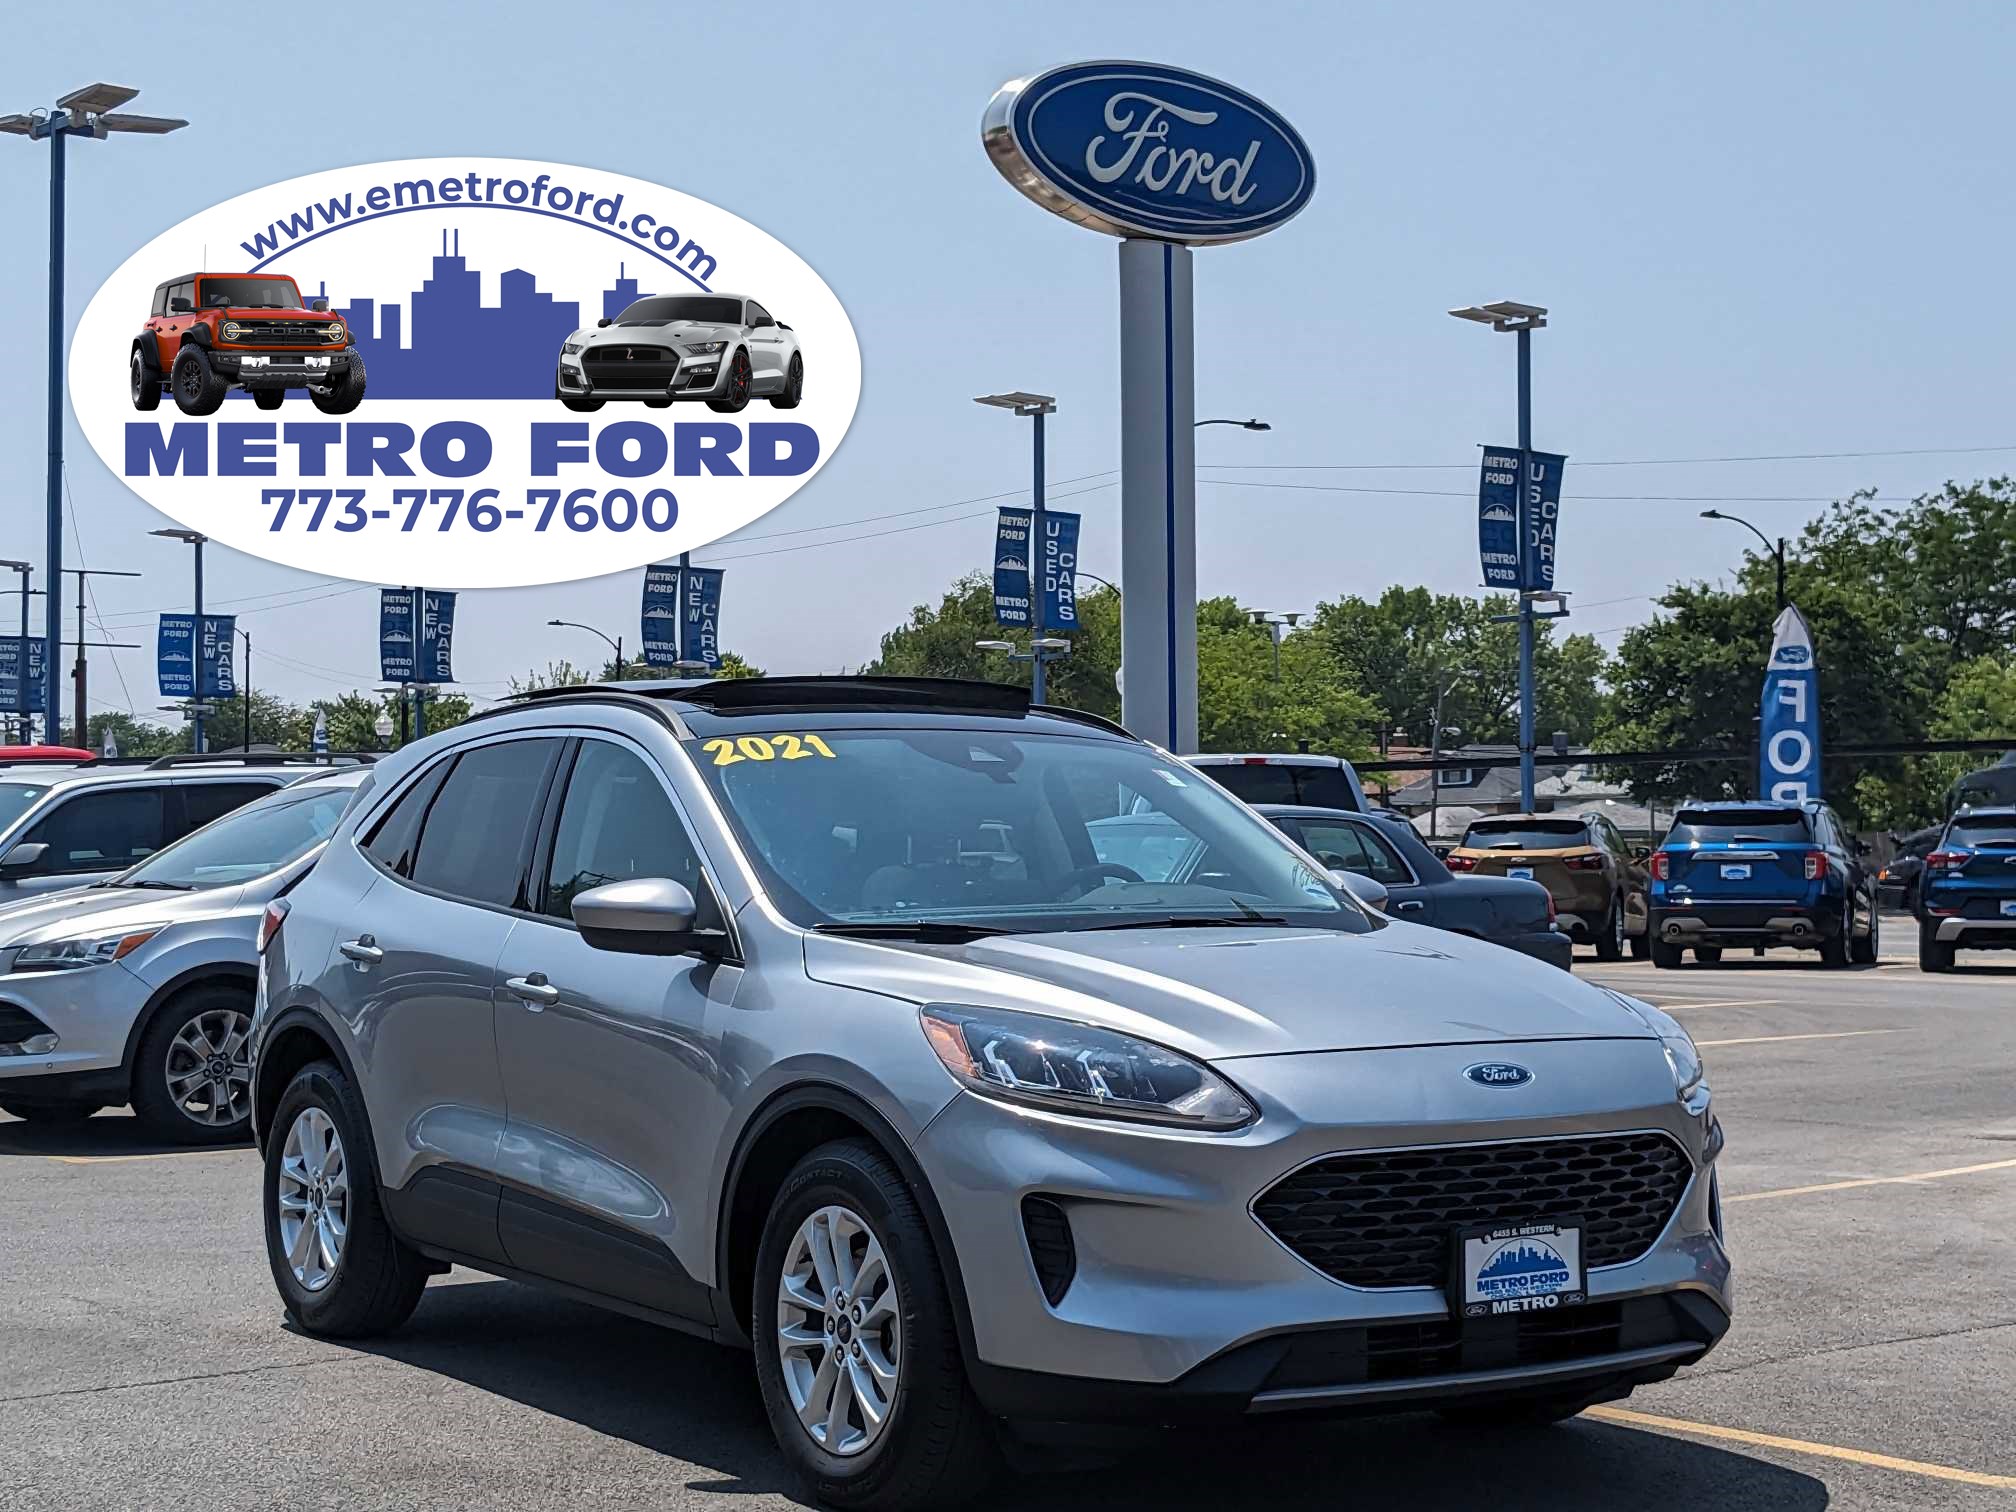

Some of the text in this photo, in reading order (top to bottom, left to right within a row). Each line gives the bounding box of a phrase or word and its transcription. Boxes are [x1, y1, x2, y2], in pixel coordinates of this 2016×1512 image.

[1085, 92, 1262, 206] Ford
[1483, 456, 1518, 470] METRO
[1485, 472, 1514, 485] FORD
[1000, 515, 1030, 527] METRO
[1000, 530, 1025, 540] FORD
[1482, 553, 1516, 565] METRO
[1487, 568, 1516, 580] FORD
[996, 596, 1029, 607] METRO
[1000, 610, 1026, 621] FORD
[702, 734, 837, 766] 2021
[1481, 1066, 1521, 1081] Ford
[1477, 1276, 1529, 1292] METRO
[1530, 1271, 1569, 1285] FORD
[1492, 1294, 1559, 1314] METRO
